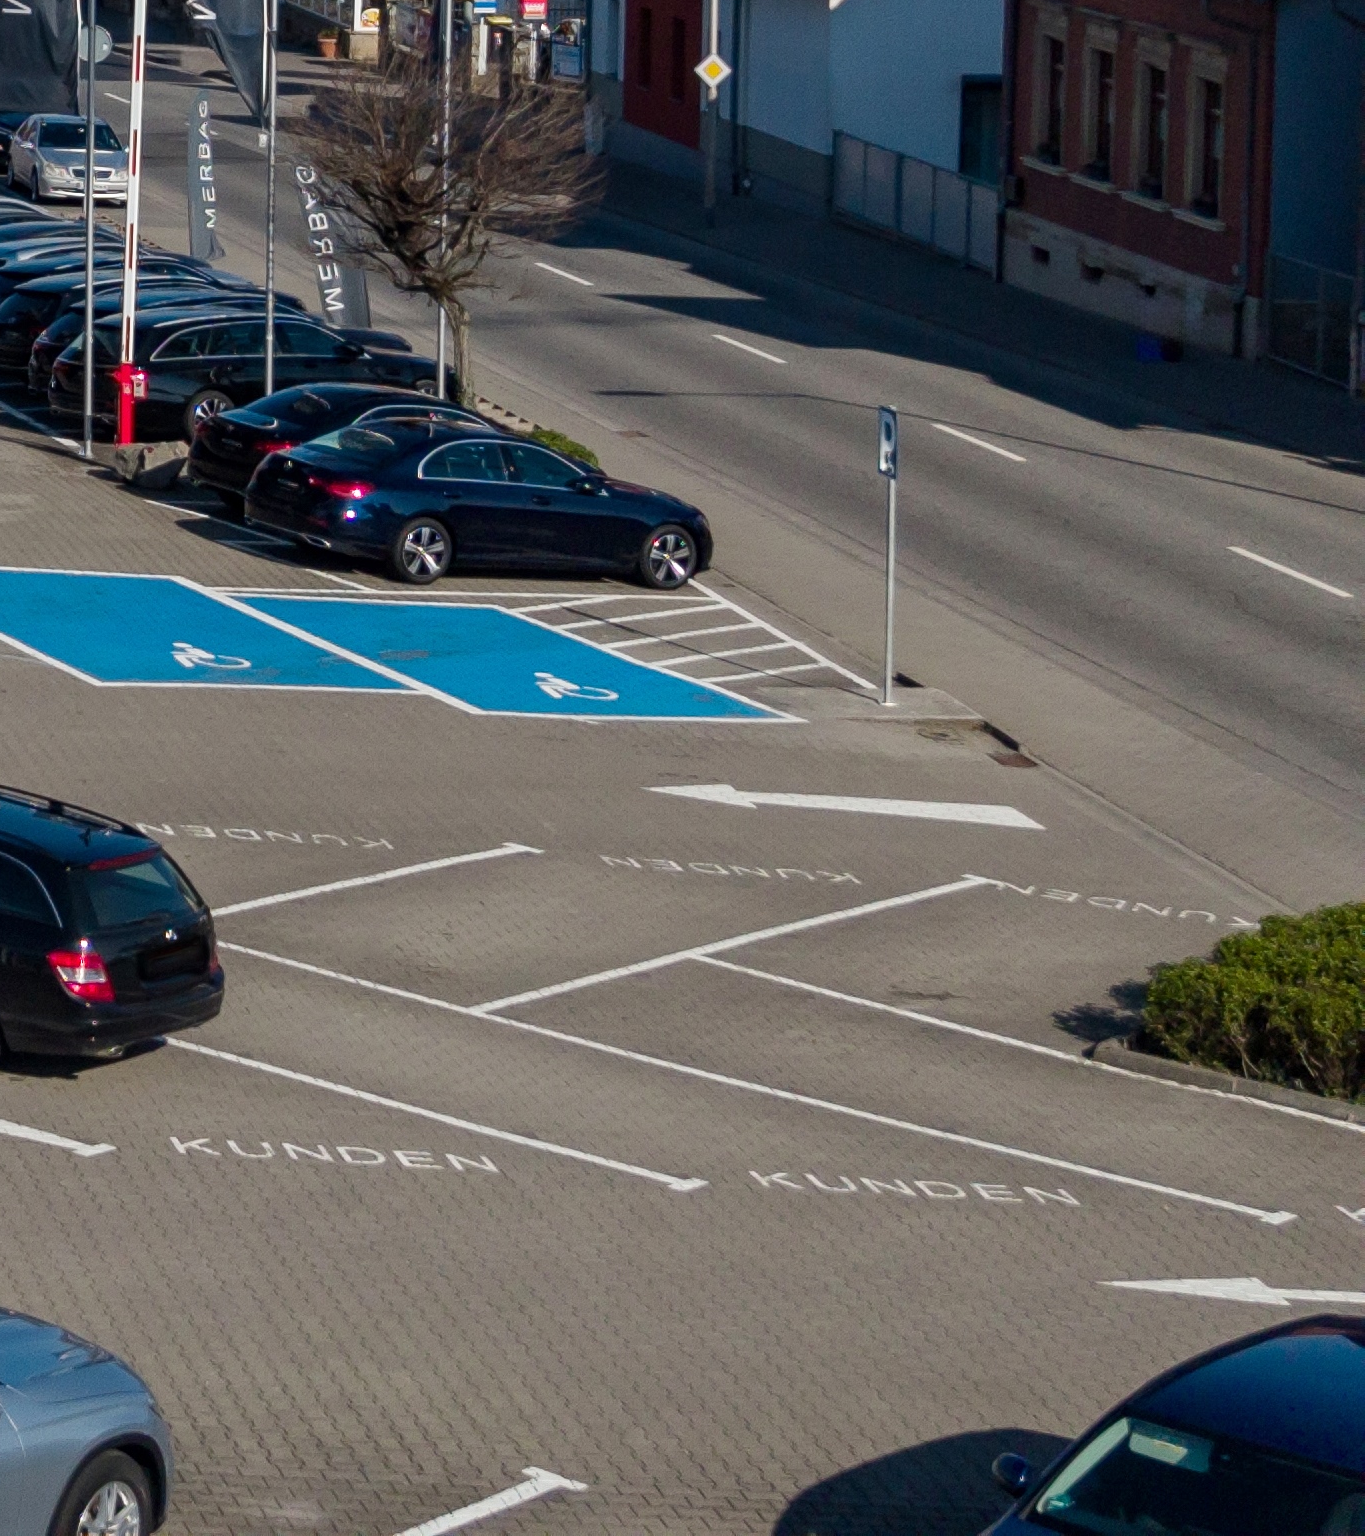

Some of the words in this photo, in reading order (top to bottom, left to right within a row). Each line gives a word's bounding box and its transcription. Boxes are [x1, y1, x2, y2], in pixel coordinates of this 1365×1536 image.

[198, 100, 217, 228] MERBAG
[134, 822, 395, 850] KUNDEN
[597, 854, 864, 885] KUNDEN
[170, 1135, 500, 1173] KUNDEN
[749, 1168, 1082, 1207] KUNDEN
